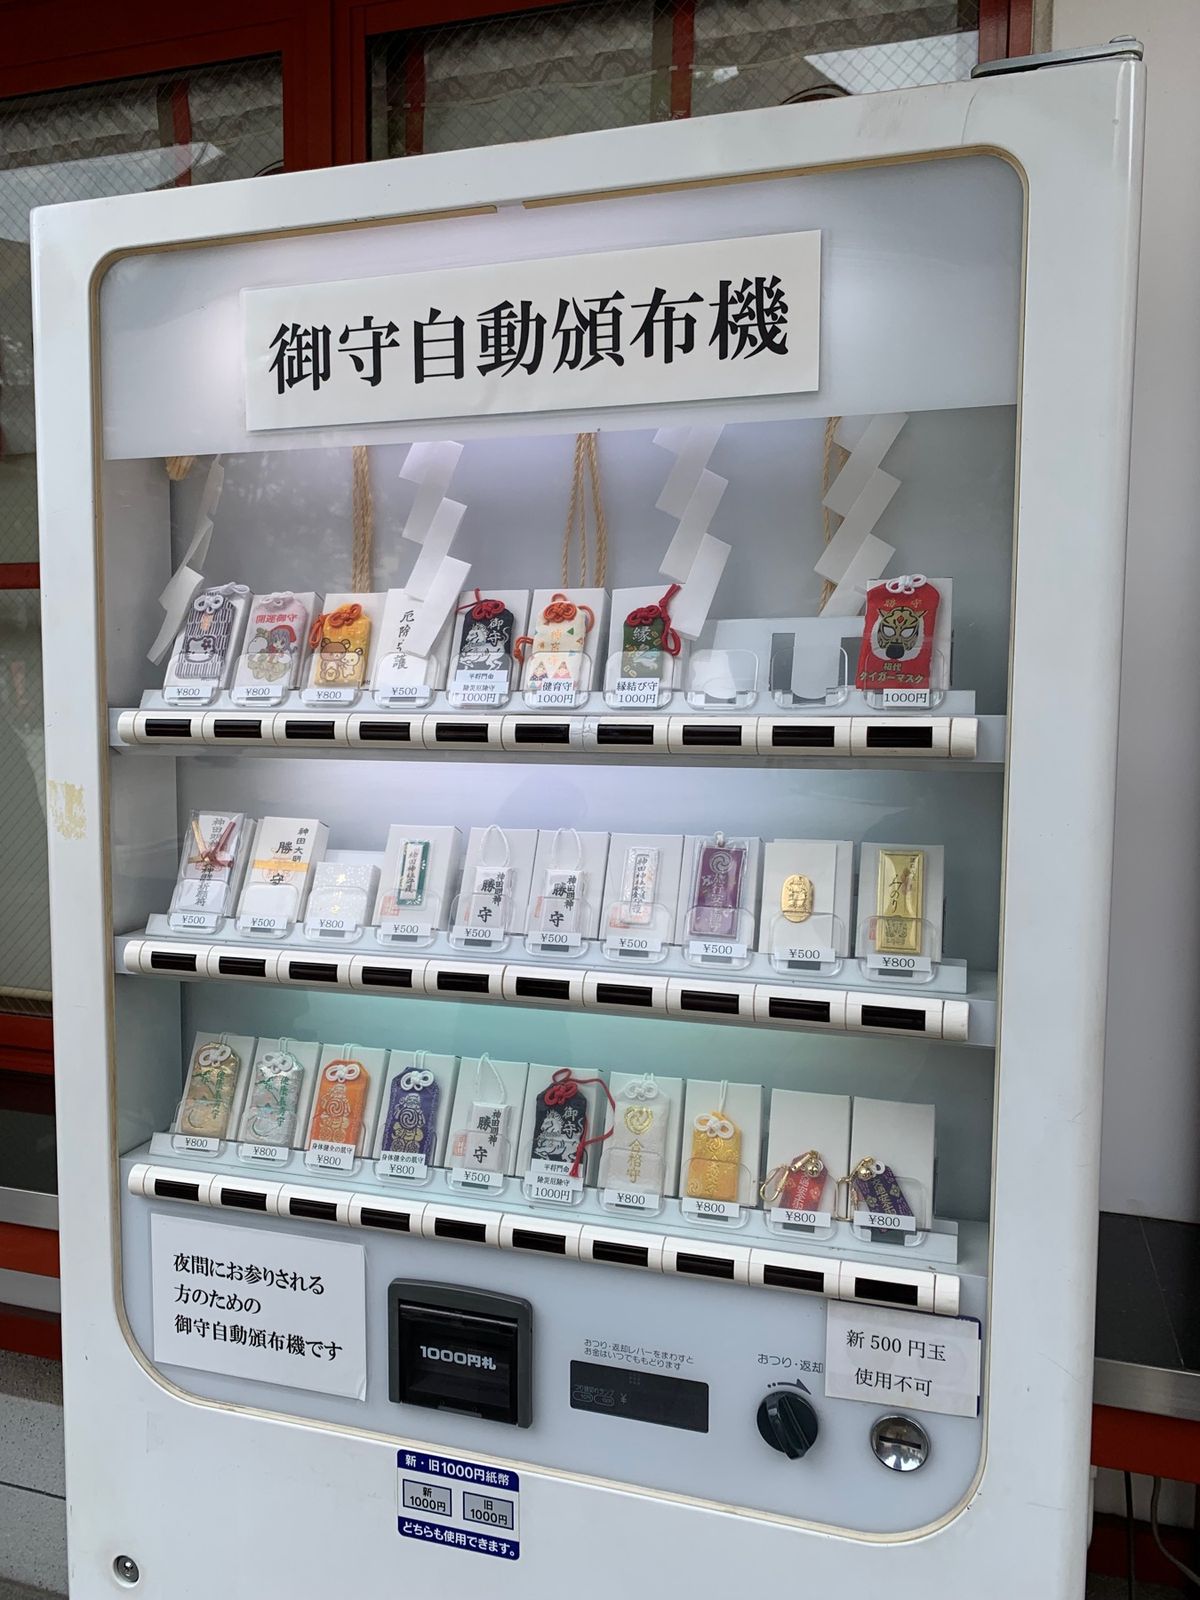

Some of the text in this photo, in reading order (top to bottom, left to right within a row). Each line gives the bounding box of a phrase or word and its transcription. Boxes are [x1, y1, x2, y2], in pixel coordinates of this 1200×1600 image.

[269, 274, 789, 395] 御守自動頒布機
[255, 614, 299, 624] 開運御守
[632, 626, 652, 643] 縁
[860, 671, 924, 685] タイガーマスク
[176, 688, 201, 697] ¥800
[245, 688, 271, 696] ¥800
[391, 687, 418, 696] ¥500
[542, 681, 573, 692] 健育守
[616, 681, 658, 692] 縁結び守
[316, 690, 342, 700] ¥800
[461, 693, 496, 704] 1000円
[537, 693, 574, 704] 1000円
[617, 694, 656, 704] 1000円
[884, 693, 927, 704] 1000円
[491, 871, 506, 907] 神田明神
[563, 875, 578, 911] 神田明神
[182, 915, 206, 925] ¥500
[251, 917, 276, 928] ¥500
[319, 918, 344, 929] ¥800
[393, 924, 419, 934] ¥500
[465, 928, 491, 939] ¥500
[540, 933, 568, 944] ¥500
[619, 938, 648, 949] ¥500
[703, 943, 733, 955] ¥500
[788, 948, 821, 960] ¥500
[882, 956, 916, 969] ¥800
[487, 1108, 502, 1147] 神田明神
[562, 1106, 578, 1140] 御守
[185, 1137, 208, 1148] ¥800
[472, 1115, 493, 1164] 勝守
[253, 1146, 278, 1158] ¥800
[317, 1154, 342, 1166] ¥800
[626, 1138, 645, 1184] 合格守
[389, 1163, 415, 1176] ¥800
[464, 1170, 491, 1183] ¥500
[534, 1186, 571, 1201] 1000円
[617, 1192, 646, 1205] ¥800
[695, 1201, 726, 1214] ¥800
[785, 1211, 817, 1224] ¥800
[868, 1215, 902, 1228] ¥800
[173, 1252, 325, 1295] 夜間にお参りされる
[174, 1283, 262, 1314] 方のための
[174, 1314, 343, 1361] 御守自動頒布機です
[419, 1345, 497, 1371] 1000円札
[583, 1347, 682, 1371] お金はいつでももどります
[757, 1352, 825, 1374] おつり・返却
[854, 1367, 933, 1397] 使用不可
[405, 1454, 510, 1487] 新・旧1000円紙幣
[422, 1487, 432, 1498] 新
[409, 1495, 446, 1513] 1000円
[483, 1499, 493, 1511] 旧
[470, 1508, 508, 1526] 1000円
[402, 1521, 516, 1557] どちらも使用できます。
